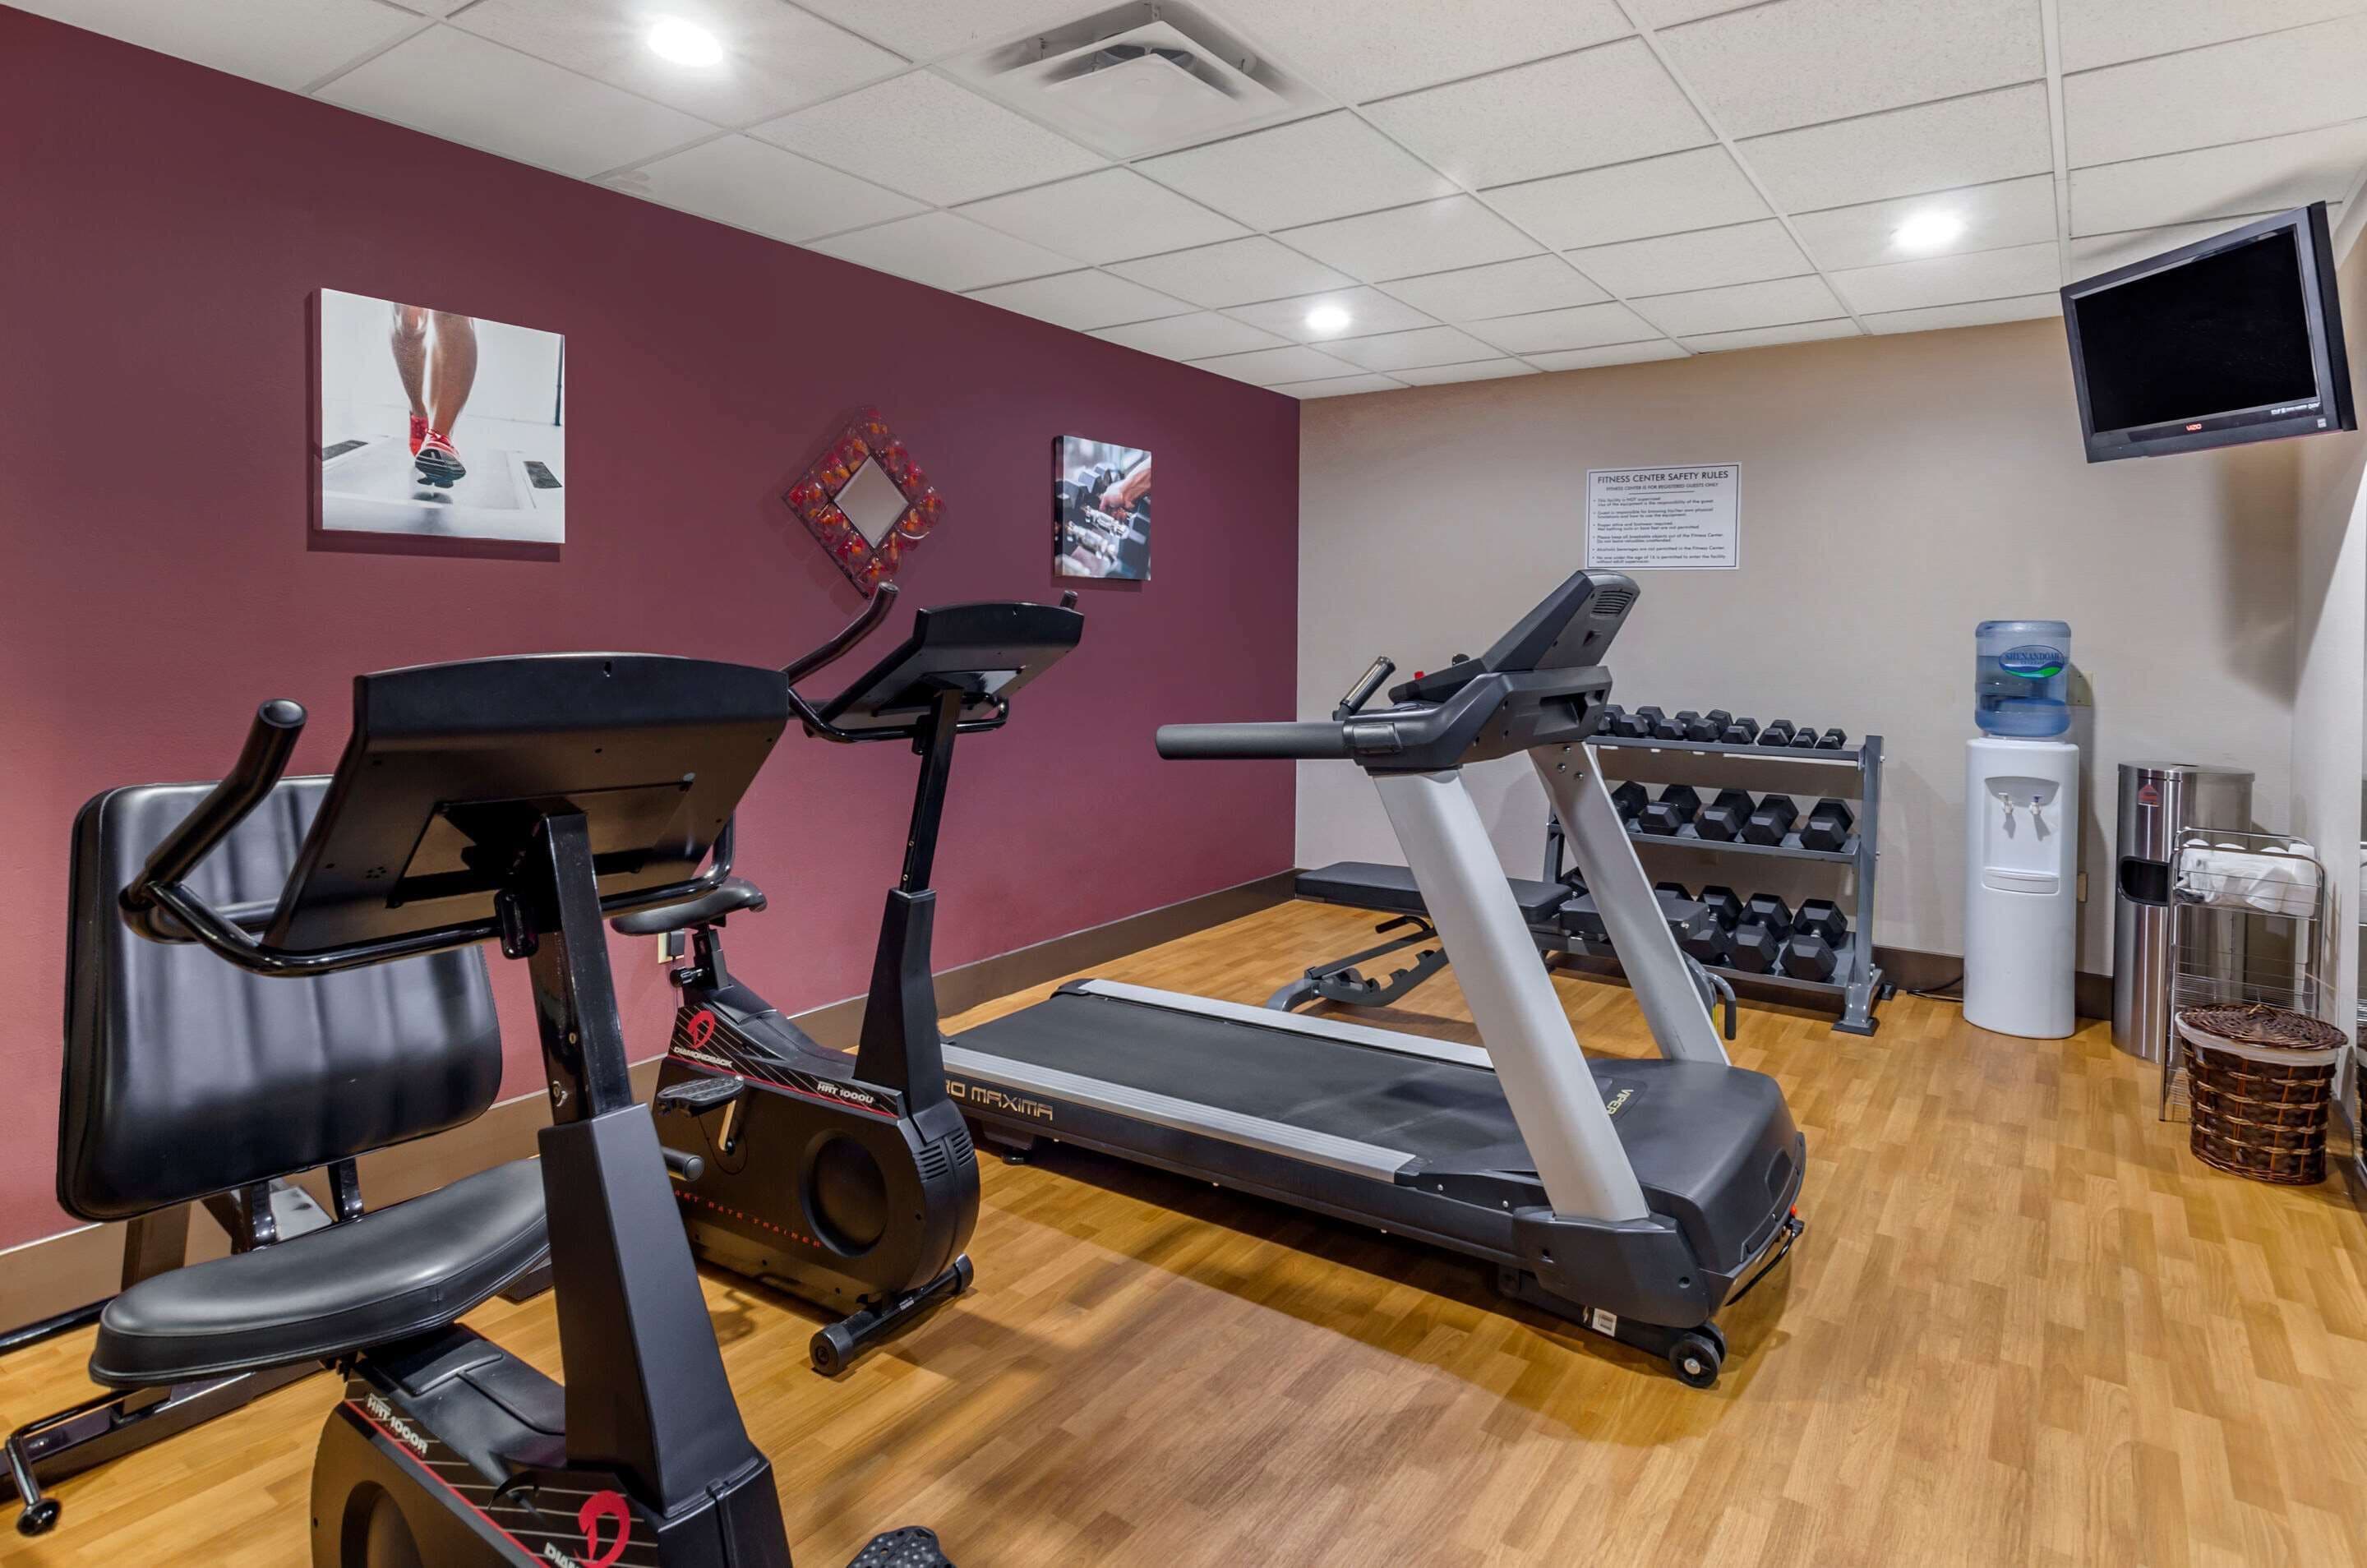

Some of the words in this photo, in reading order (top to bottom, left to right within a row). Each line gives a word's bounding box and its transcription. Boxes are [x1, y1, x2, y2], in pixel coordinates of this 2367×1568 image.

[1598, 475, 1630, 483] FITNESS
[1632, 473, 1665, 482] CENTER
[1668, 472, 1698, 480] SAFETY
[1701, 470, 1728, 479] RULES
[971, 1086, 1053, 1121] MAXIMA
[753, 1217, 822, 1248] TRAINER
